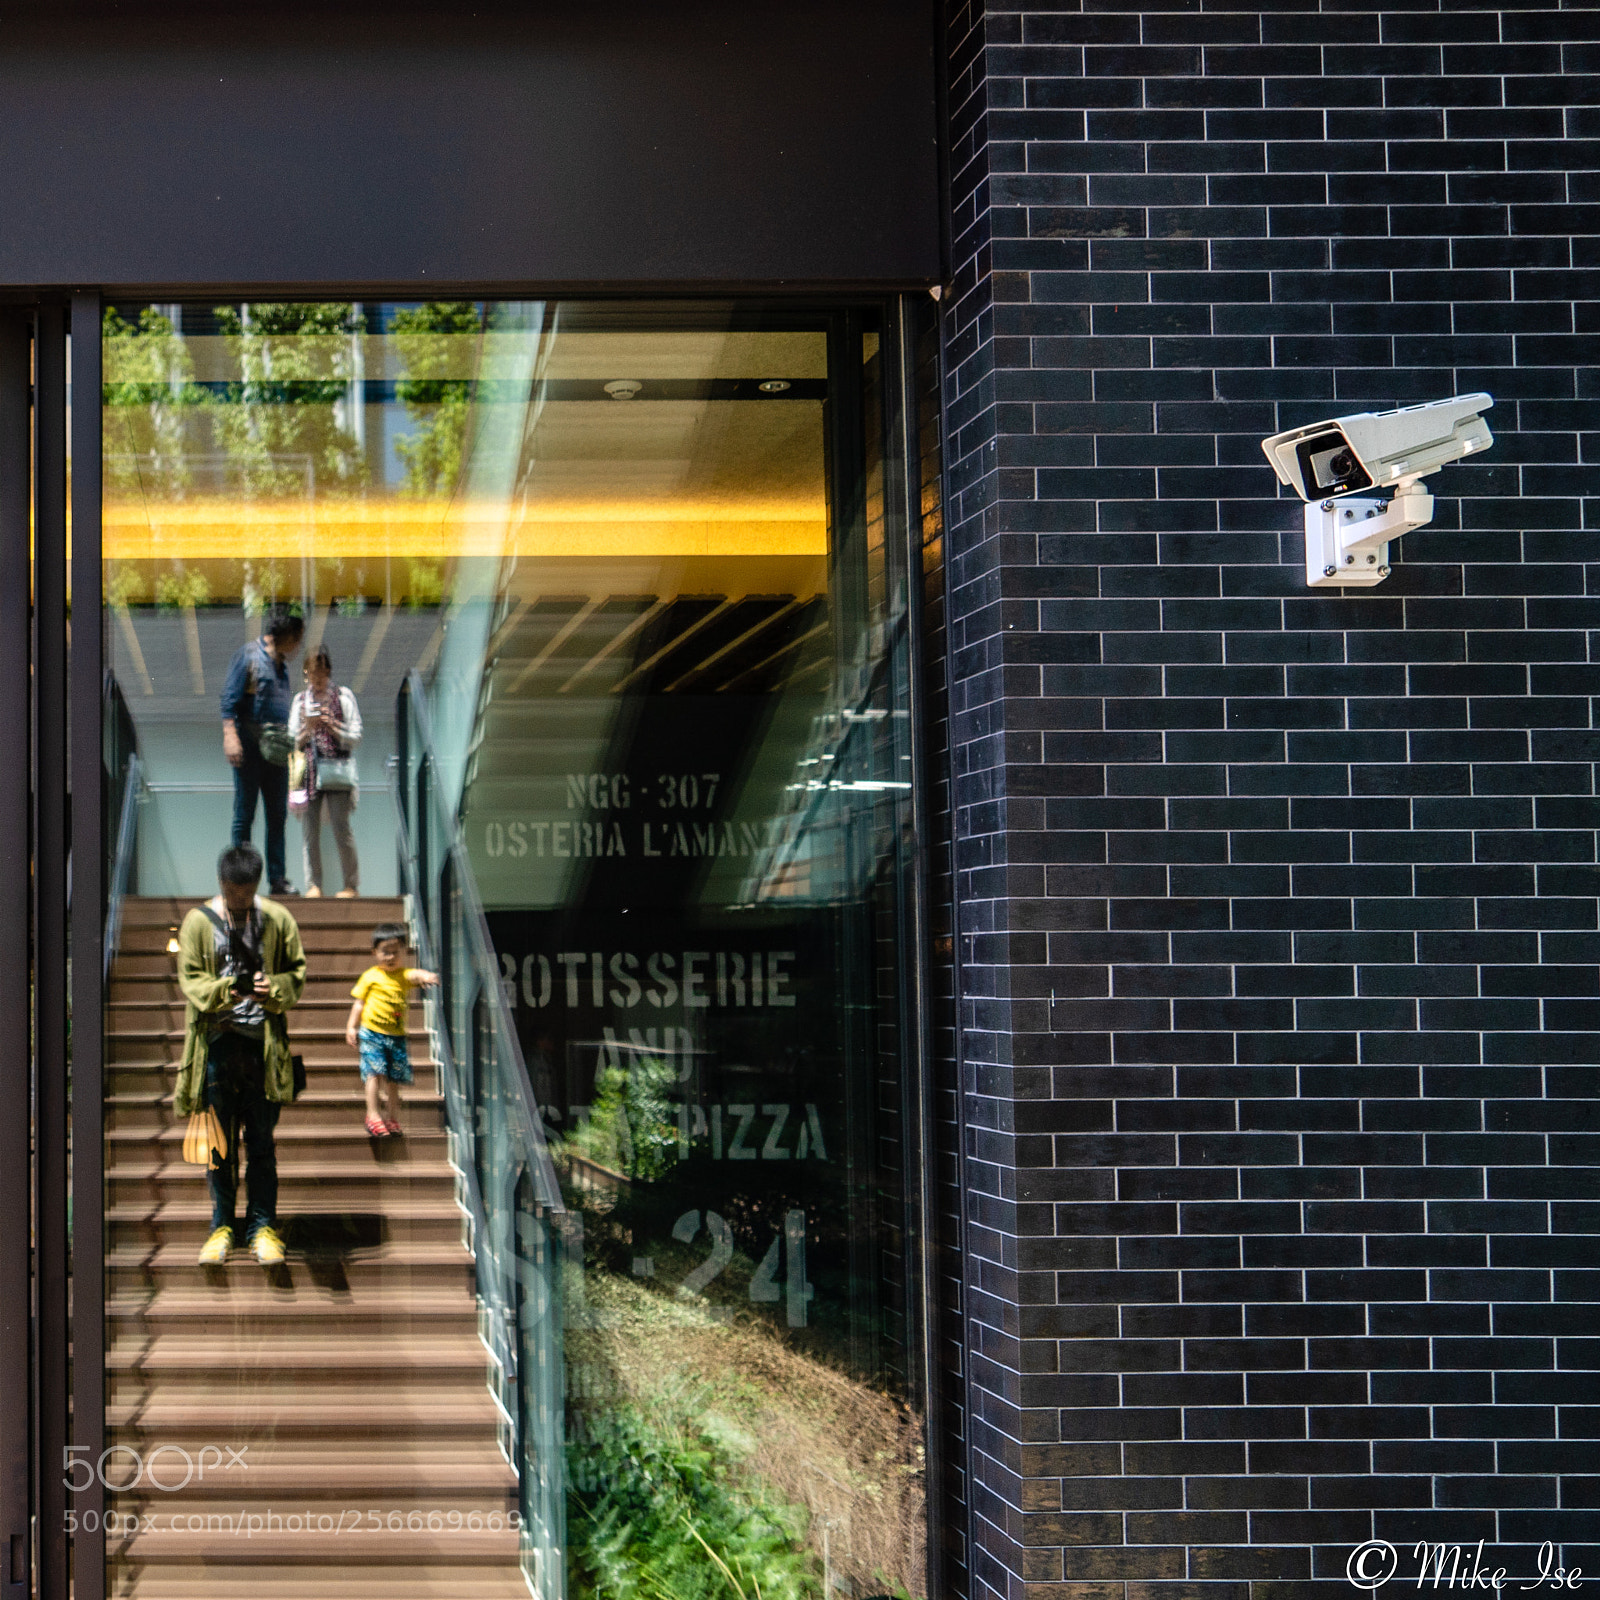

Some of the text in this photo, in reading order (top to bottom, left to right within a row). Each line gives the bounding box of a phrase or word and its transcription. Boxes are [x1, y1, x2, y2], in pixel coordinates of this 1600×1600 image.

[485, 821, 627, 858] OSTERIA
[593, 1026, 694, 1083] AND
[674, 1103, 828, 1161] PIZZA
